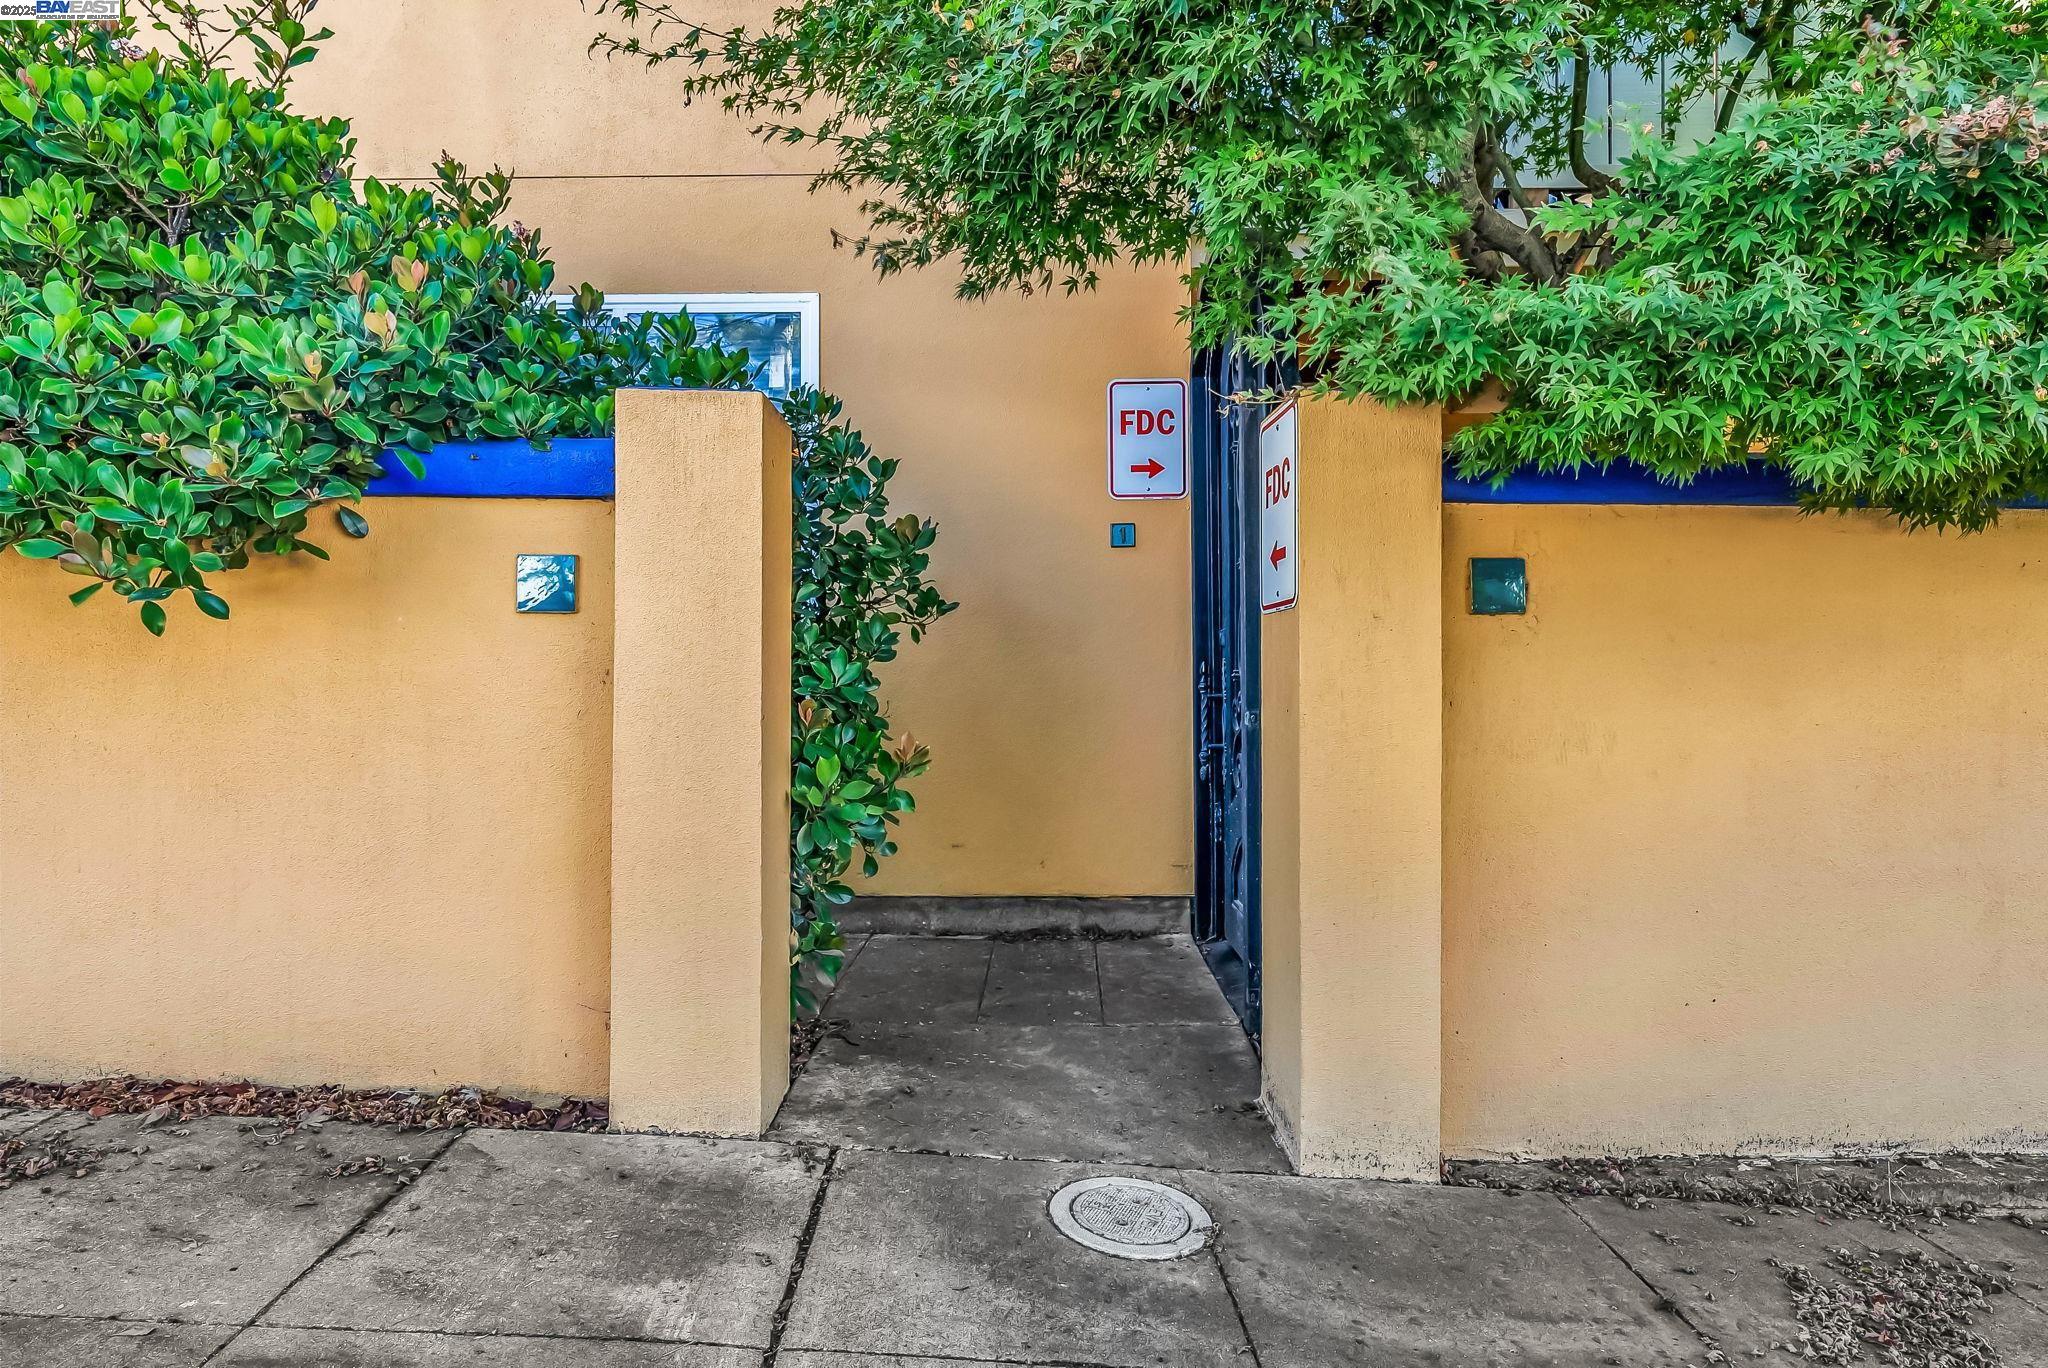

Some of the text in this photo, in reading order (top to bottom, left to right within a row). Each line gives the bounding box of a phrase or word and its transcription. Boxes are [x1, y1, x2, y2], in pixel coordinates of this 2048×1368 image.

[1120, 409, 1176, 436] FDC
[1265, 457, 1291, 510] FDC
[1118, 526, 1128, 545] 1
